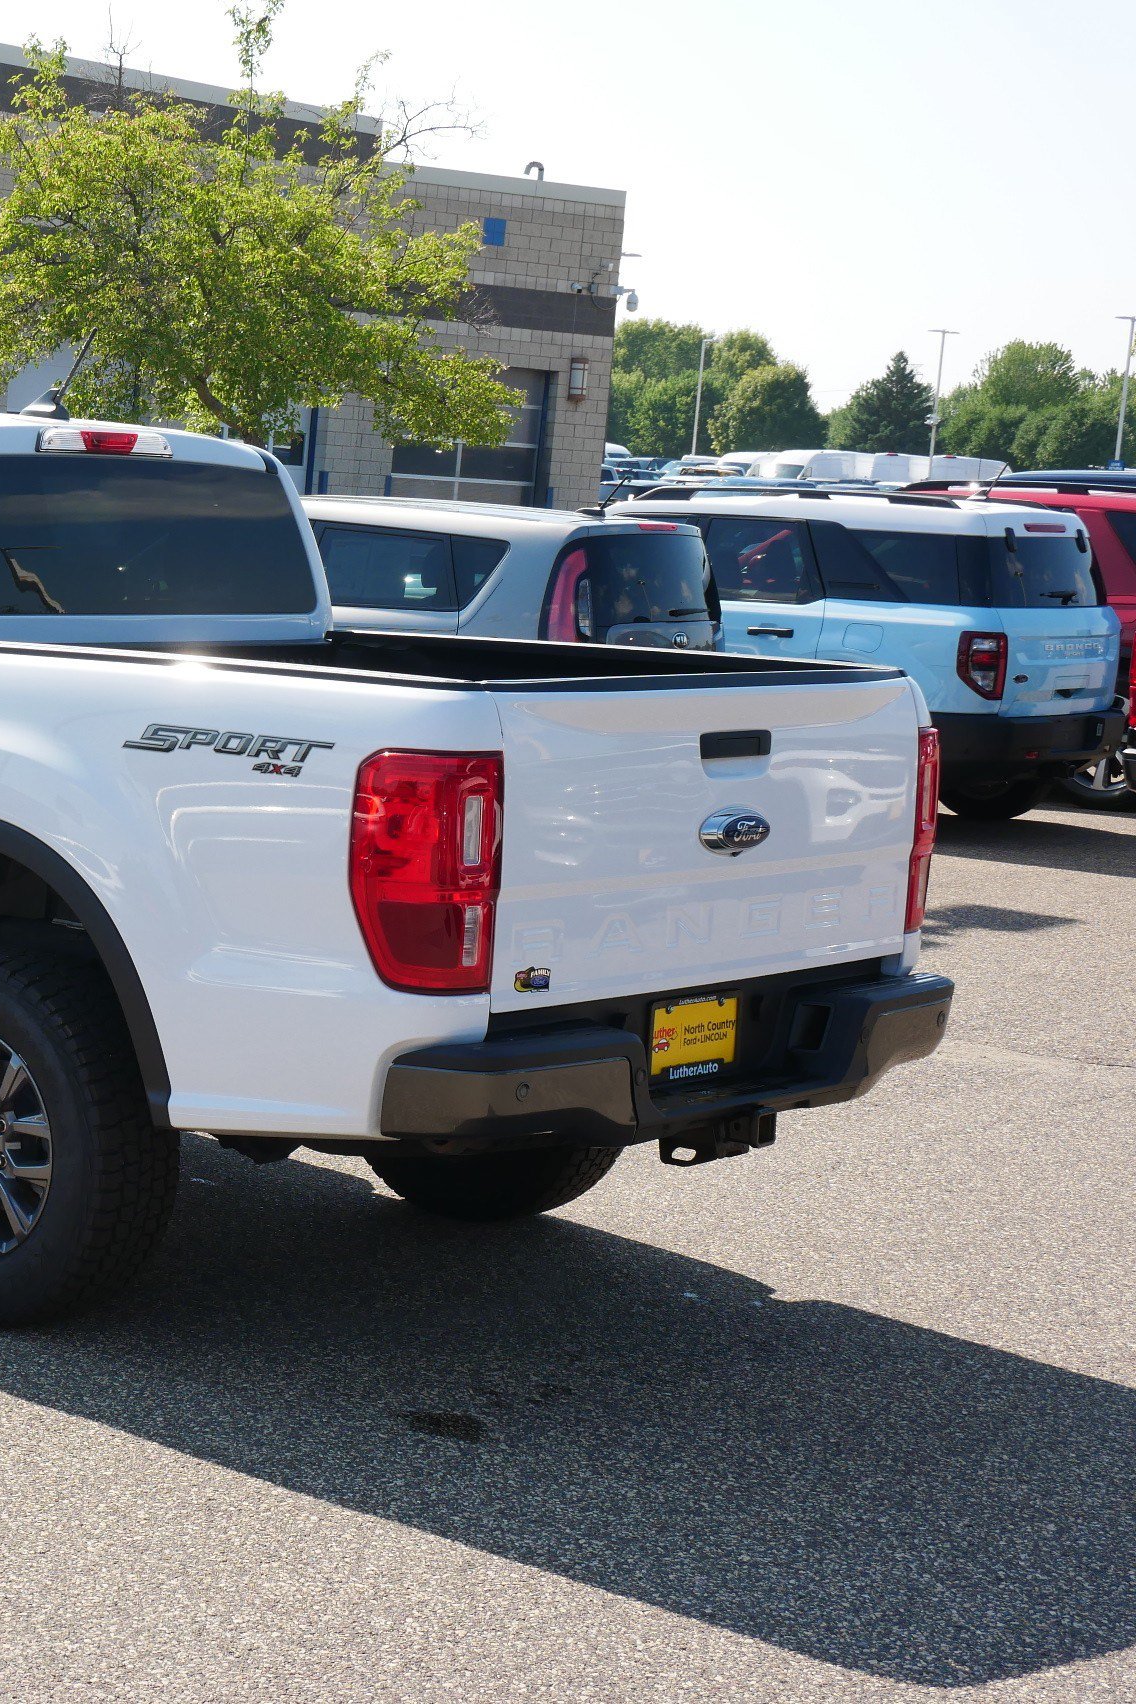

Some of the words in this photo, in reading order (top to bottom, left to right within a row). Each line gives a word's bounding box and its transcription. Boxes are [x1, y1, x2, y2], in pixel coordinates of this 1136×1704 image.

[1044, 642, 1101, 651] BRONCO
[123, 723, 335, 763] SPORT
[733, 820, 762, 842] Ford
[510, 884, 897, 965] RANGER
[530, 969, 550, 978] FAMILY
[679, 995, 717, 1005] LutherAuto.com
[684, 1022, 704, 1035] North
[707, 1019, 736, 1031] Country
[669, 1062, 718, 1079] LutherAuto
